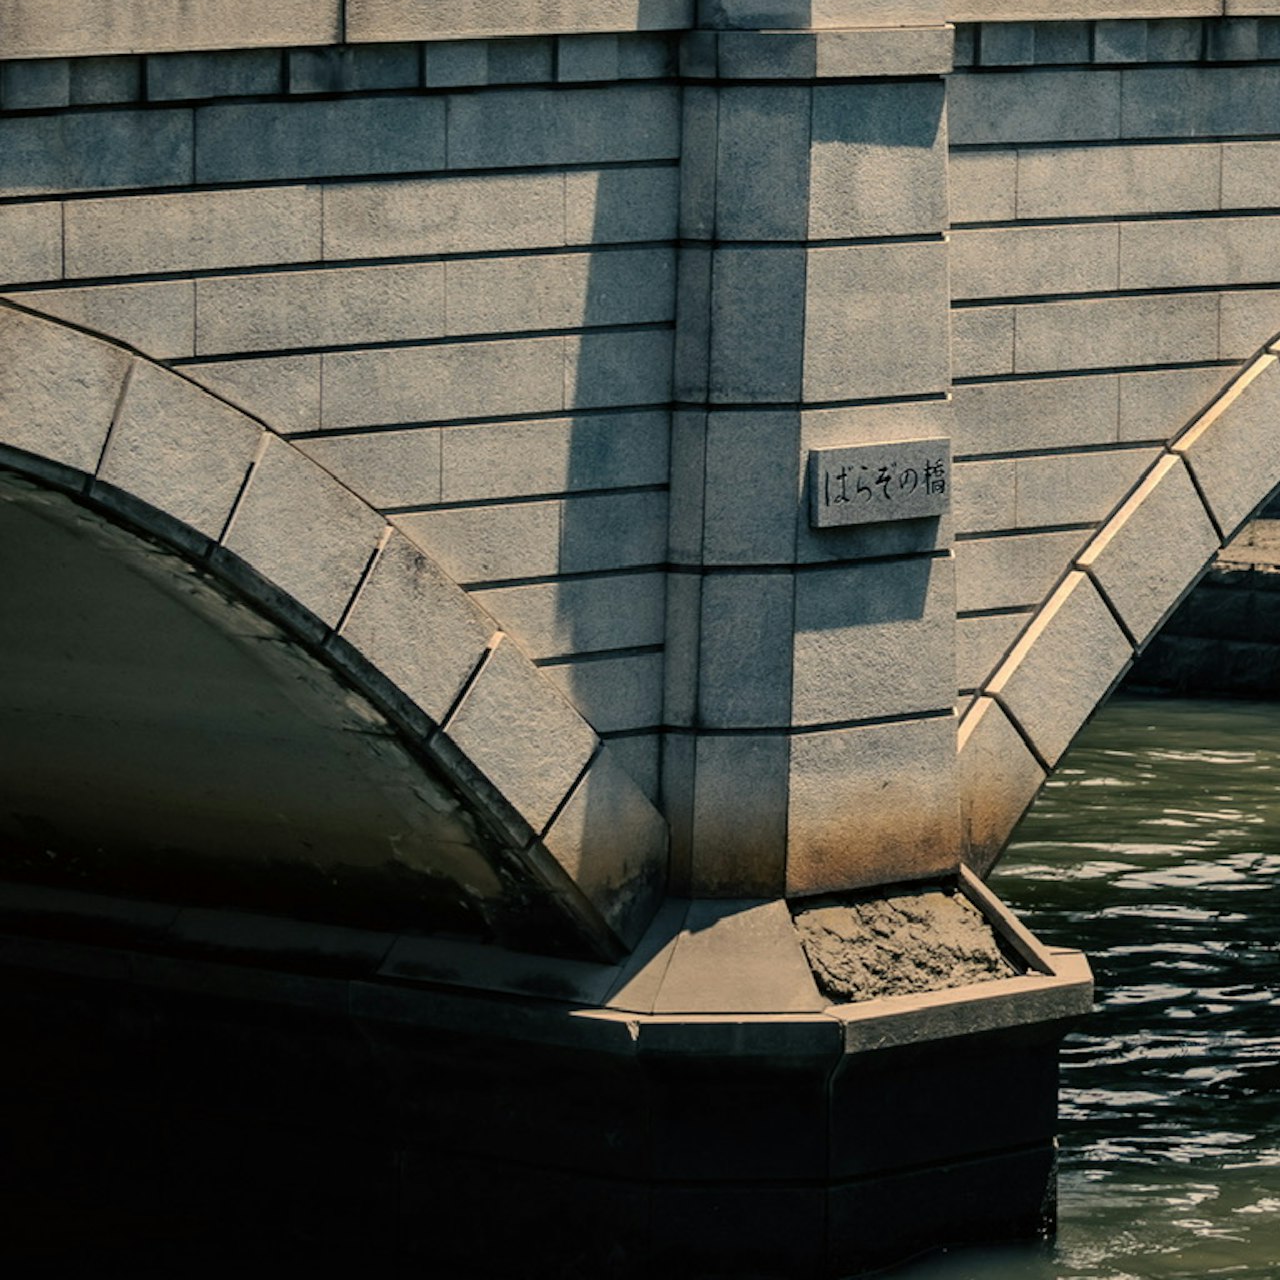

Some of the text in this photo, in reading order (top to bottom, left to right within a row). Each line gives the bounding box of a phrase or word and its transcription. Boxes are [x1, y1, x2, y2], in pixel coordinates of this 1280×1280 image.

[824, 459, 946, 507] ばらぞの橋
